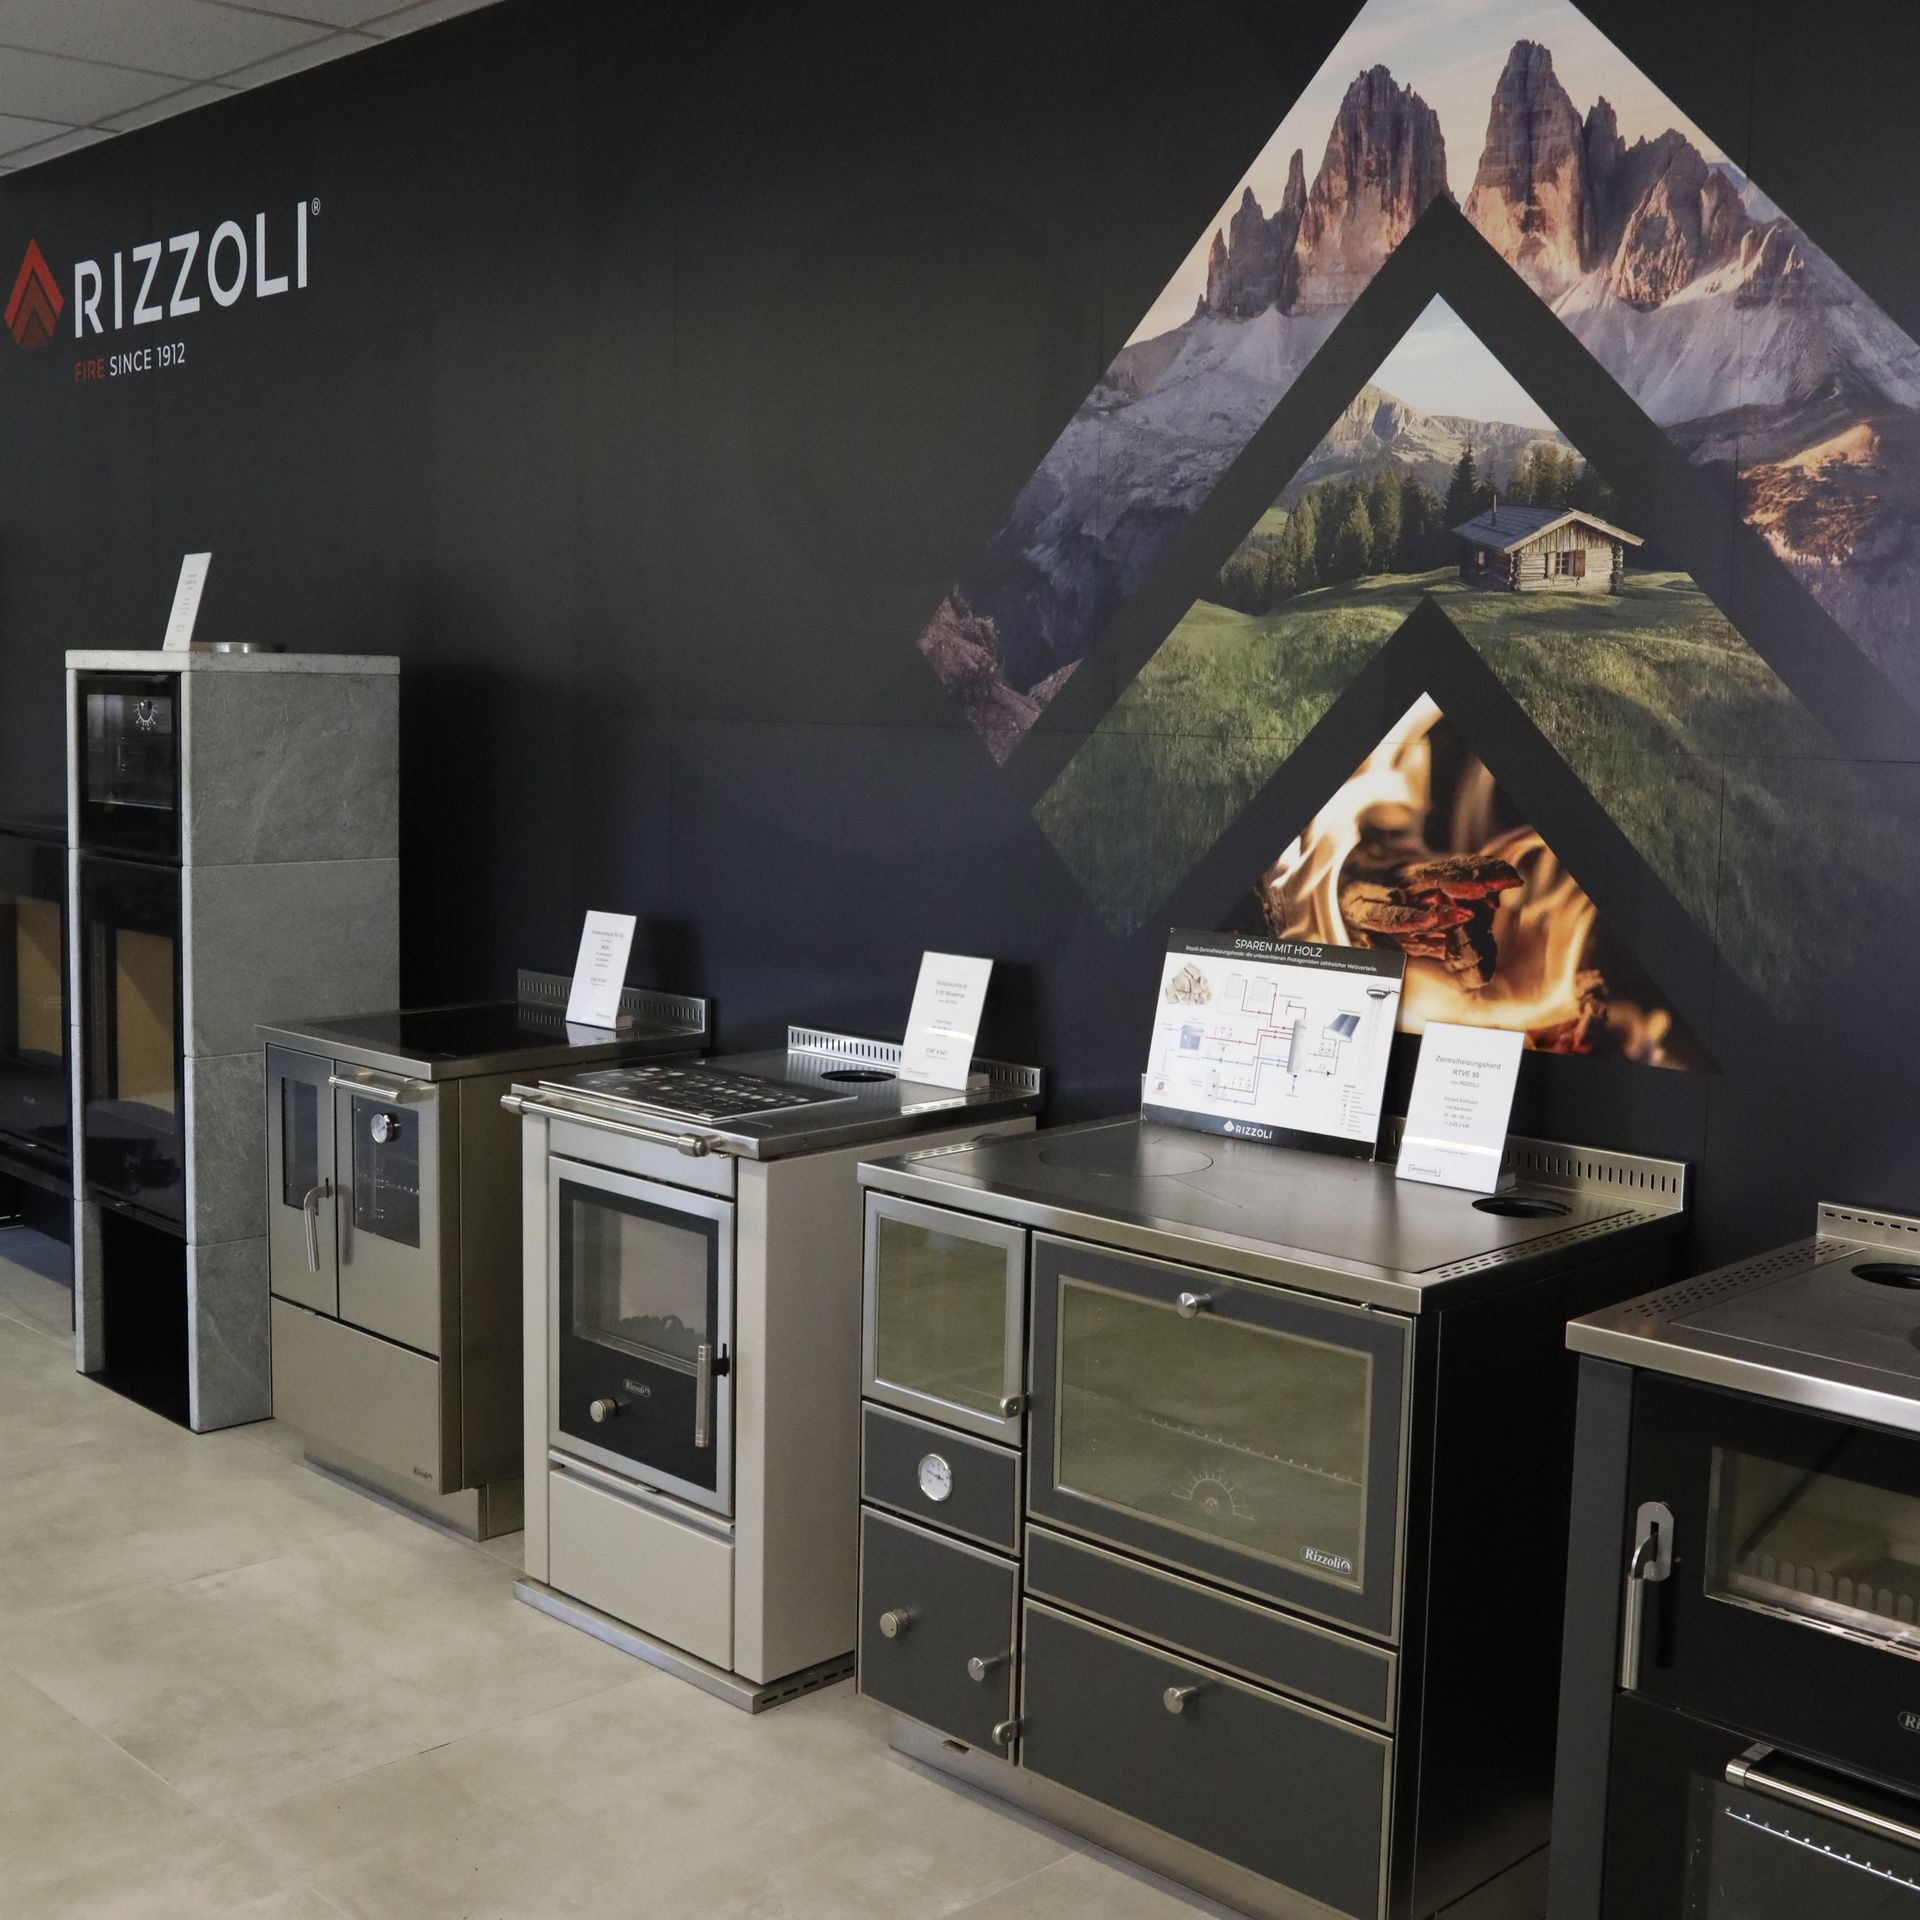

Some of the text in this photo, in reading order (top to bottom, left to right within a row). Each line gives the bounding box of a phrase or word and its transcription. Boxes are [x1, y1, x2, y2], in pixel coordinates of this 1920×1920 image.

[75, 342, 185, 382] FIRE SINCE 1912
[1235, 938, 1323, 957] SPAREN MIT HOLZ
[1435, 1055, 1502, 1070] Zentralheizungsherd
[1452, 1069, 1471, 1078] RTVE
[1235, 1125, 1273, 1140] RIZZOLI
[1305, 1548, 1341, 1569] Rizzoli
